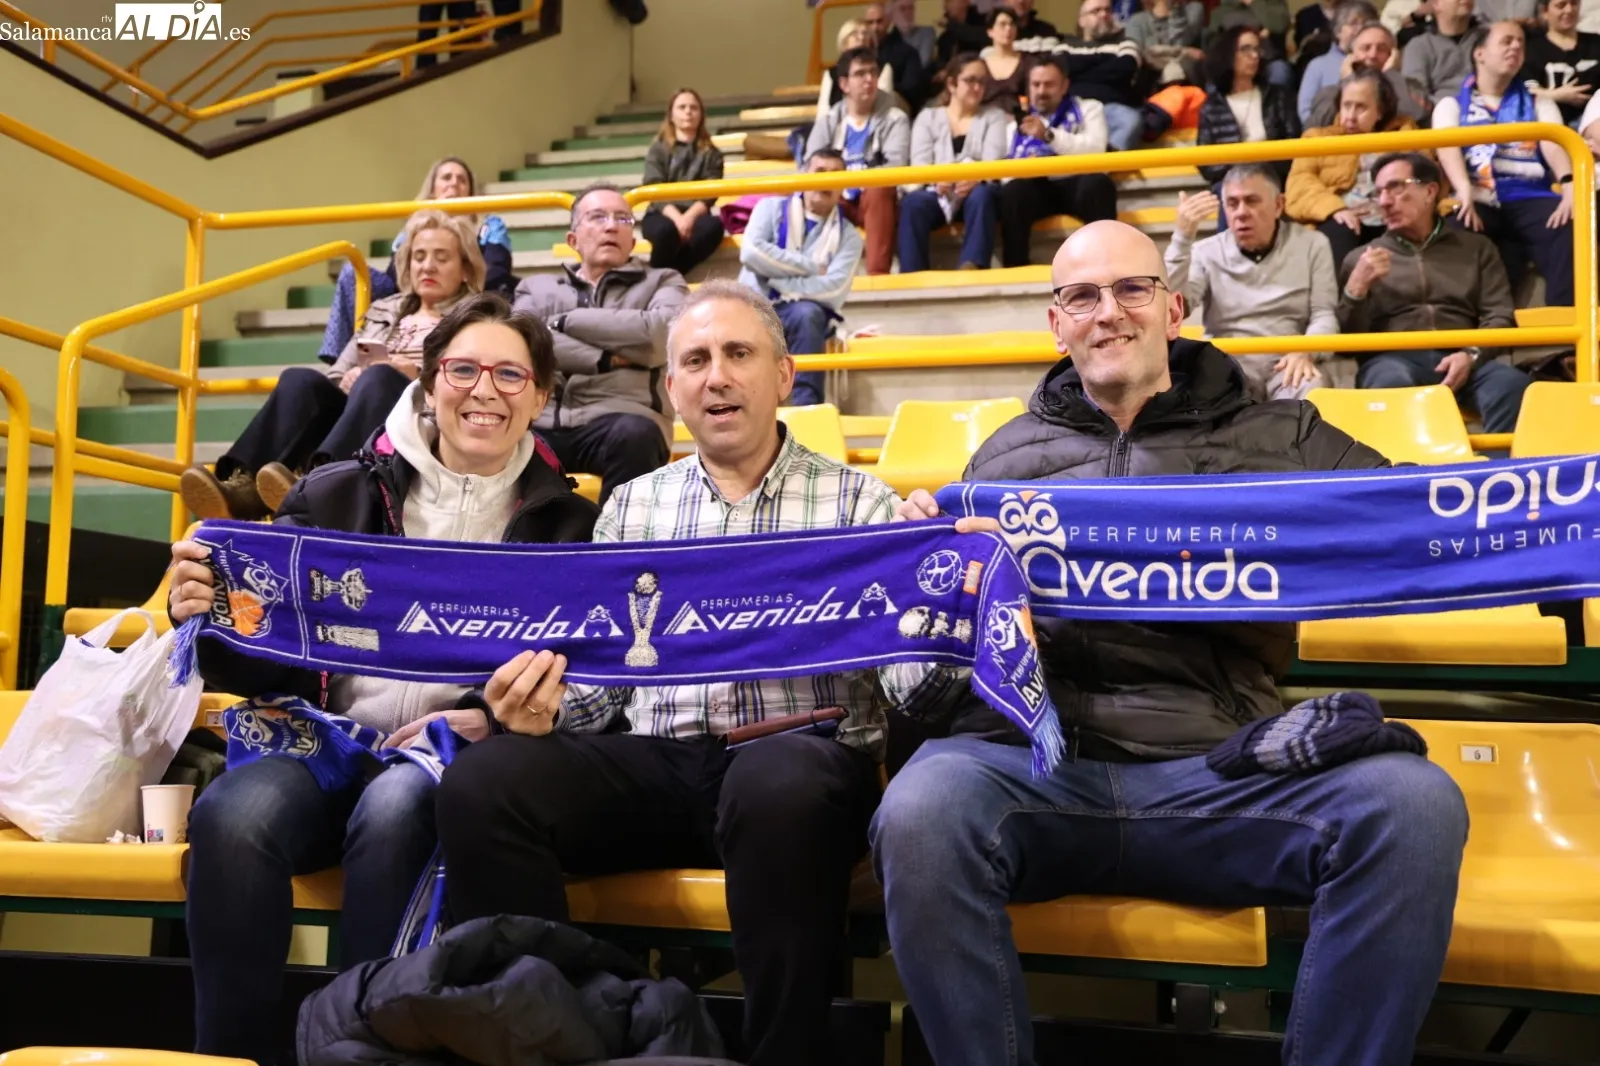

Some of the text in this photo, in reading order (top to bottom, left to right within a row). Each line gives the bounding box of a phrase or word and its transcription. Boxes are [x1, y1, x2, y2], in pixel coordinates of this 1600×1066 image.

[1429, 461, 1600, 529] nida
[1069, 523, 1278, 543] PERFUMERÍAS
[430, 602, 520, 618] PERFUMERIAS
[662, 586, 845, 635] Avenida
[700, 593, 794, 610] PERFUMERIAS
[397, 601, 571, 641] Avenida
[1473, 749, 1482, 761] 6
